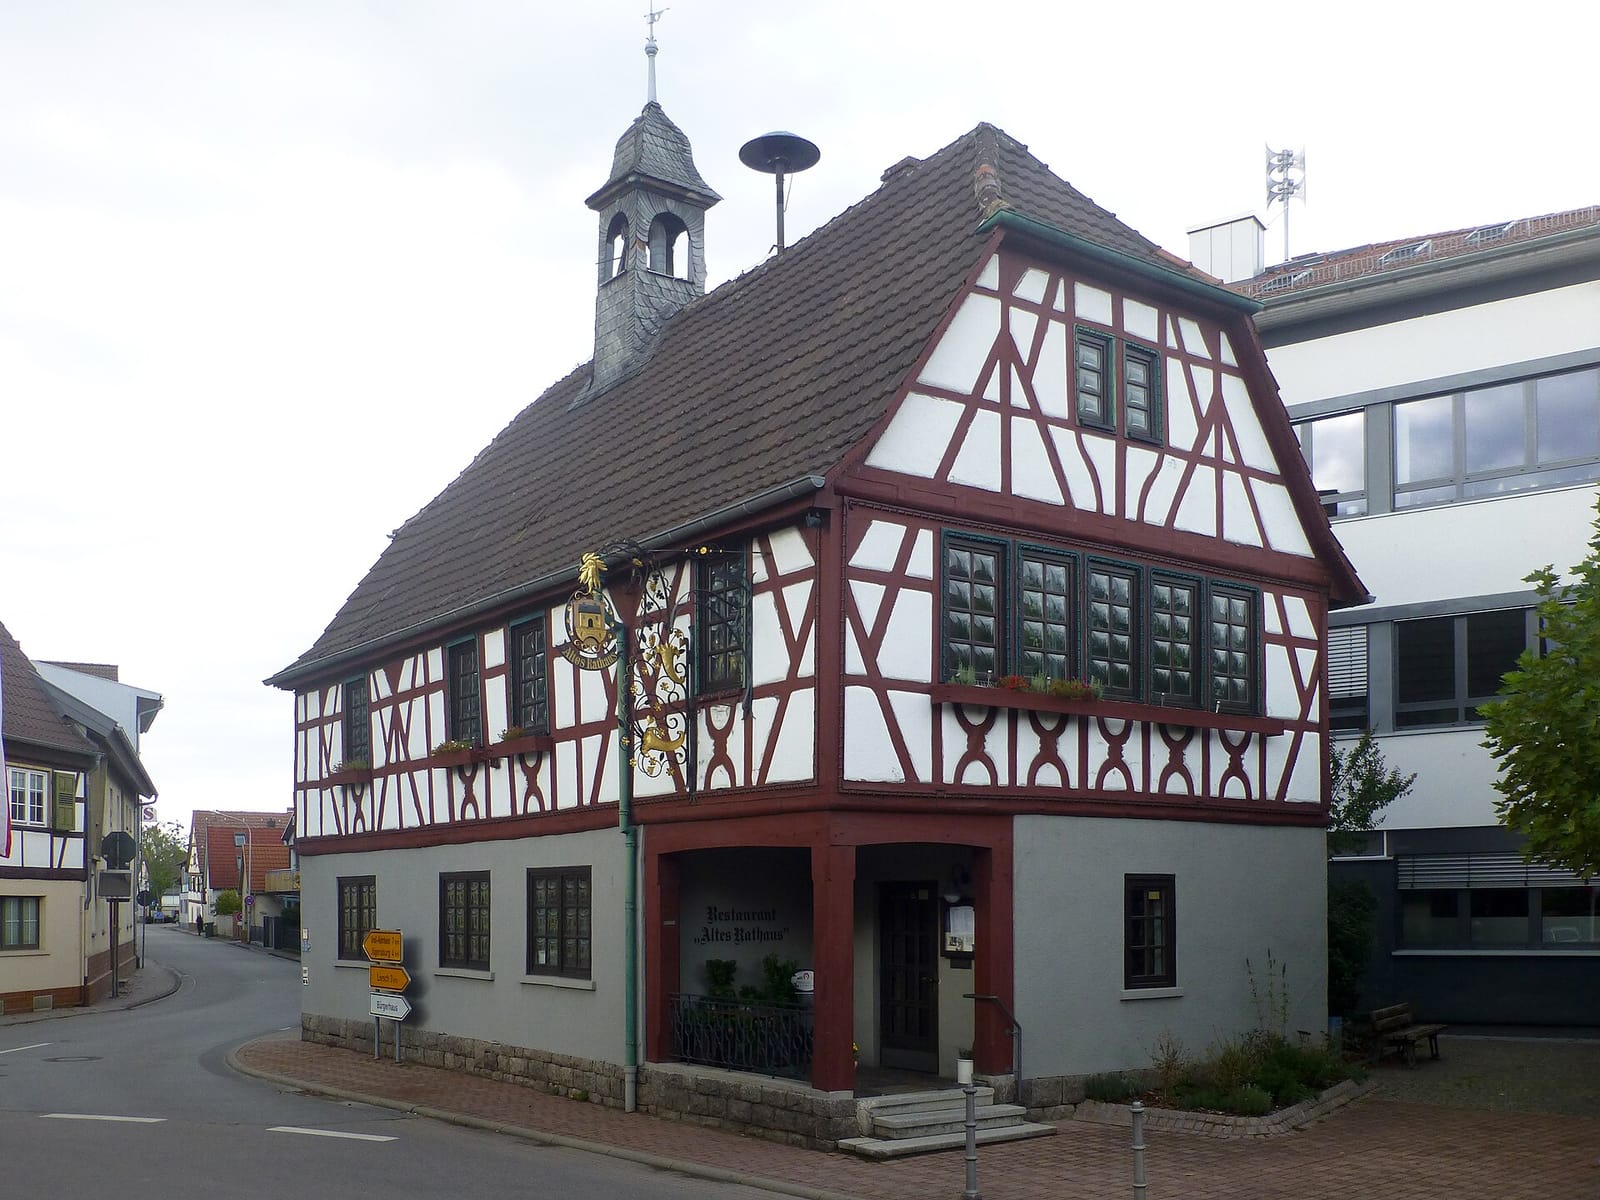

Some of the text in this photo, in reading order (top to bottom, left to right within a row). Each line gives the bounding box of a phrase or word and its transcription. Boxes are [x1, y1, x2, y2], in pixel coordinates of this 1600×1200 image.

[562, 647, 618, 669] Altes Rathaus
[705, 906, 777, 924] Restaurant
